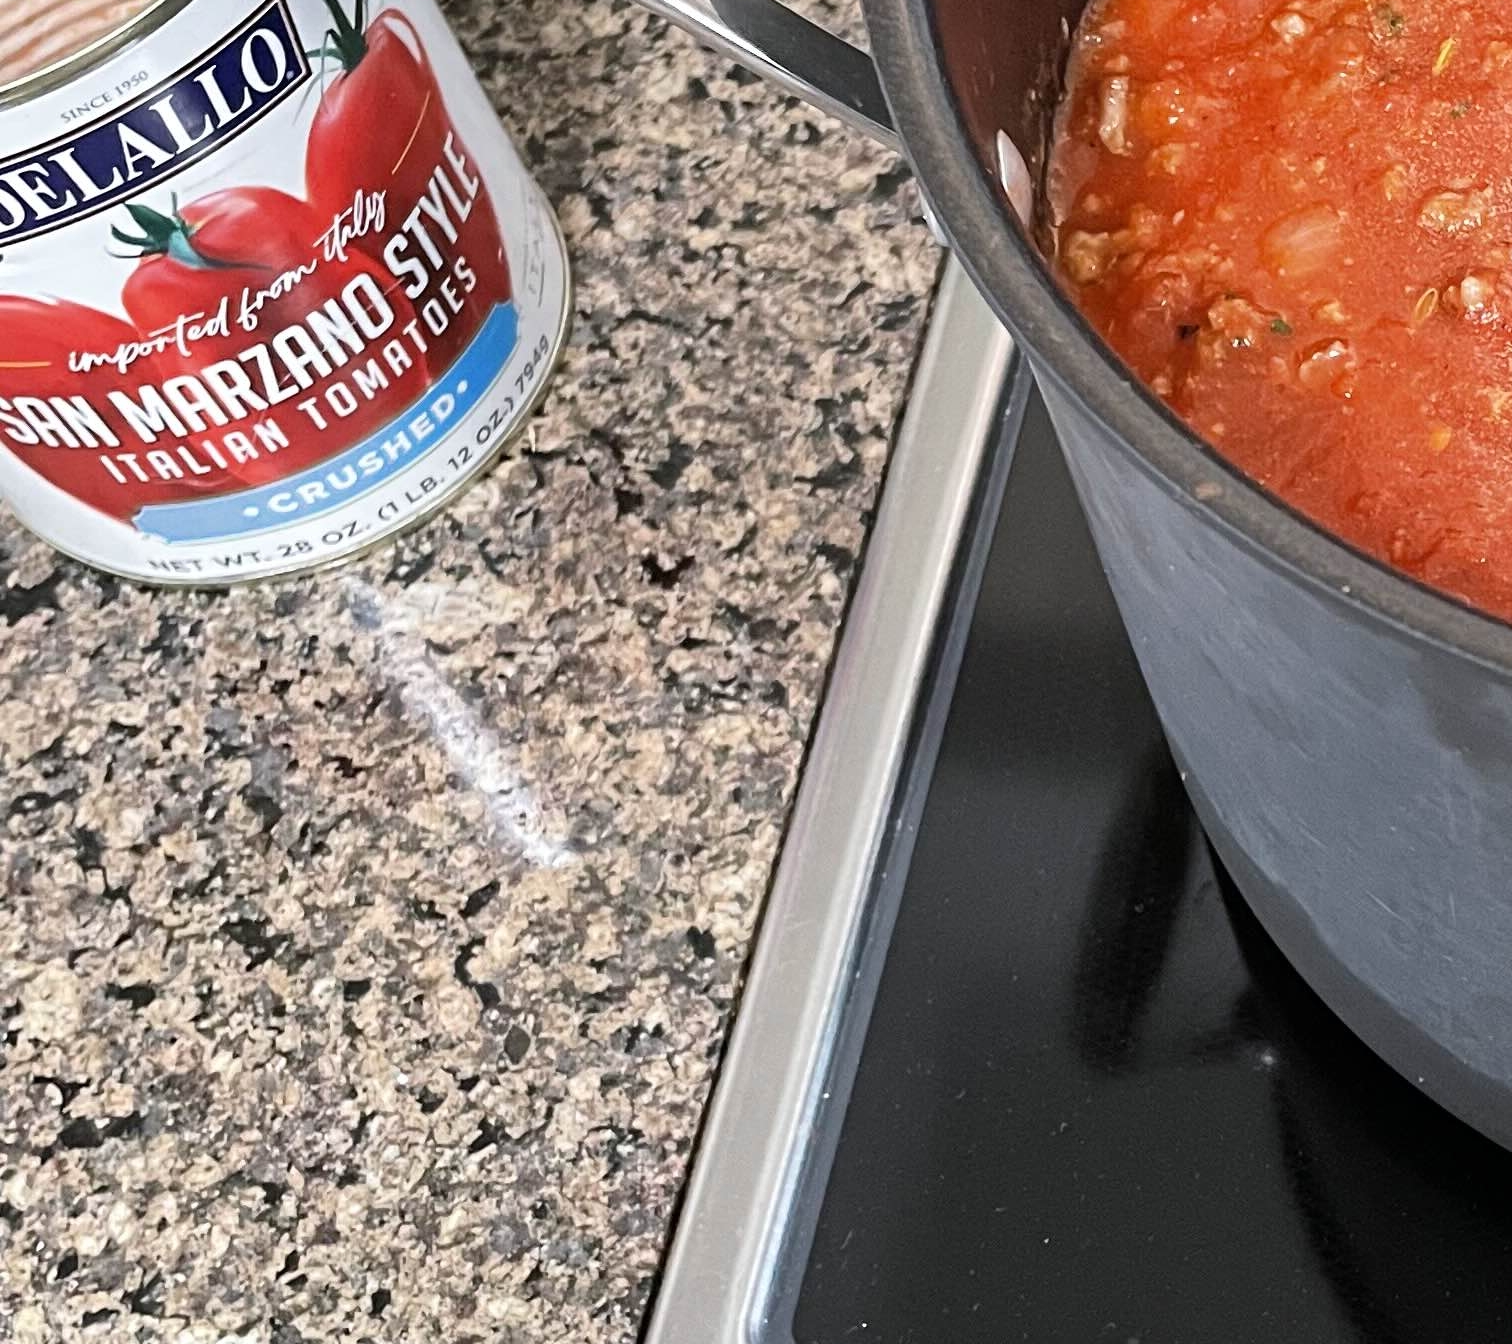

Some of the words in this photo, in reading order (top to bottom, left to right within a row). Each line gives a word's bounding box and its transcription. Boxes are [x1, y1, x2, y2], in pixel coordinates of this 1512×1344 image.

[60, 92, 112, 123] SINCE
[117, 70, 150, 97] 1950
[0, 396, 120, 448] SAN
[106, 270, 396, 444] MARZANO
[384, 130, 480, 301] STYLE
[68, 296, 230, 374] imported
[236, 258, 318, 327] from
[100, 419, 290, 484] ITALIAN
[298, 256, 477, 430] TOMATOES
[148, 558, 203, 574] NET
[212, 550, 273, 569] WT.
[281, 540, 314, 559] 28
[321, 519, 371, 546] OZ.
[404, 474, 447, 504] LB.
[448, 446, 474, 470] 12
[266, 397, 458, 513] CRUSHED
